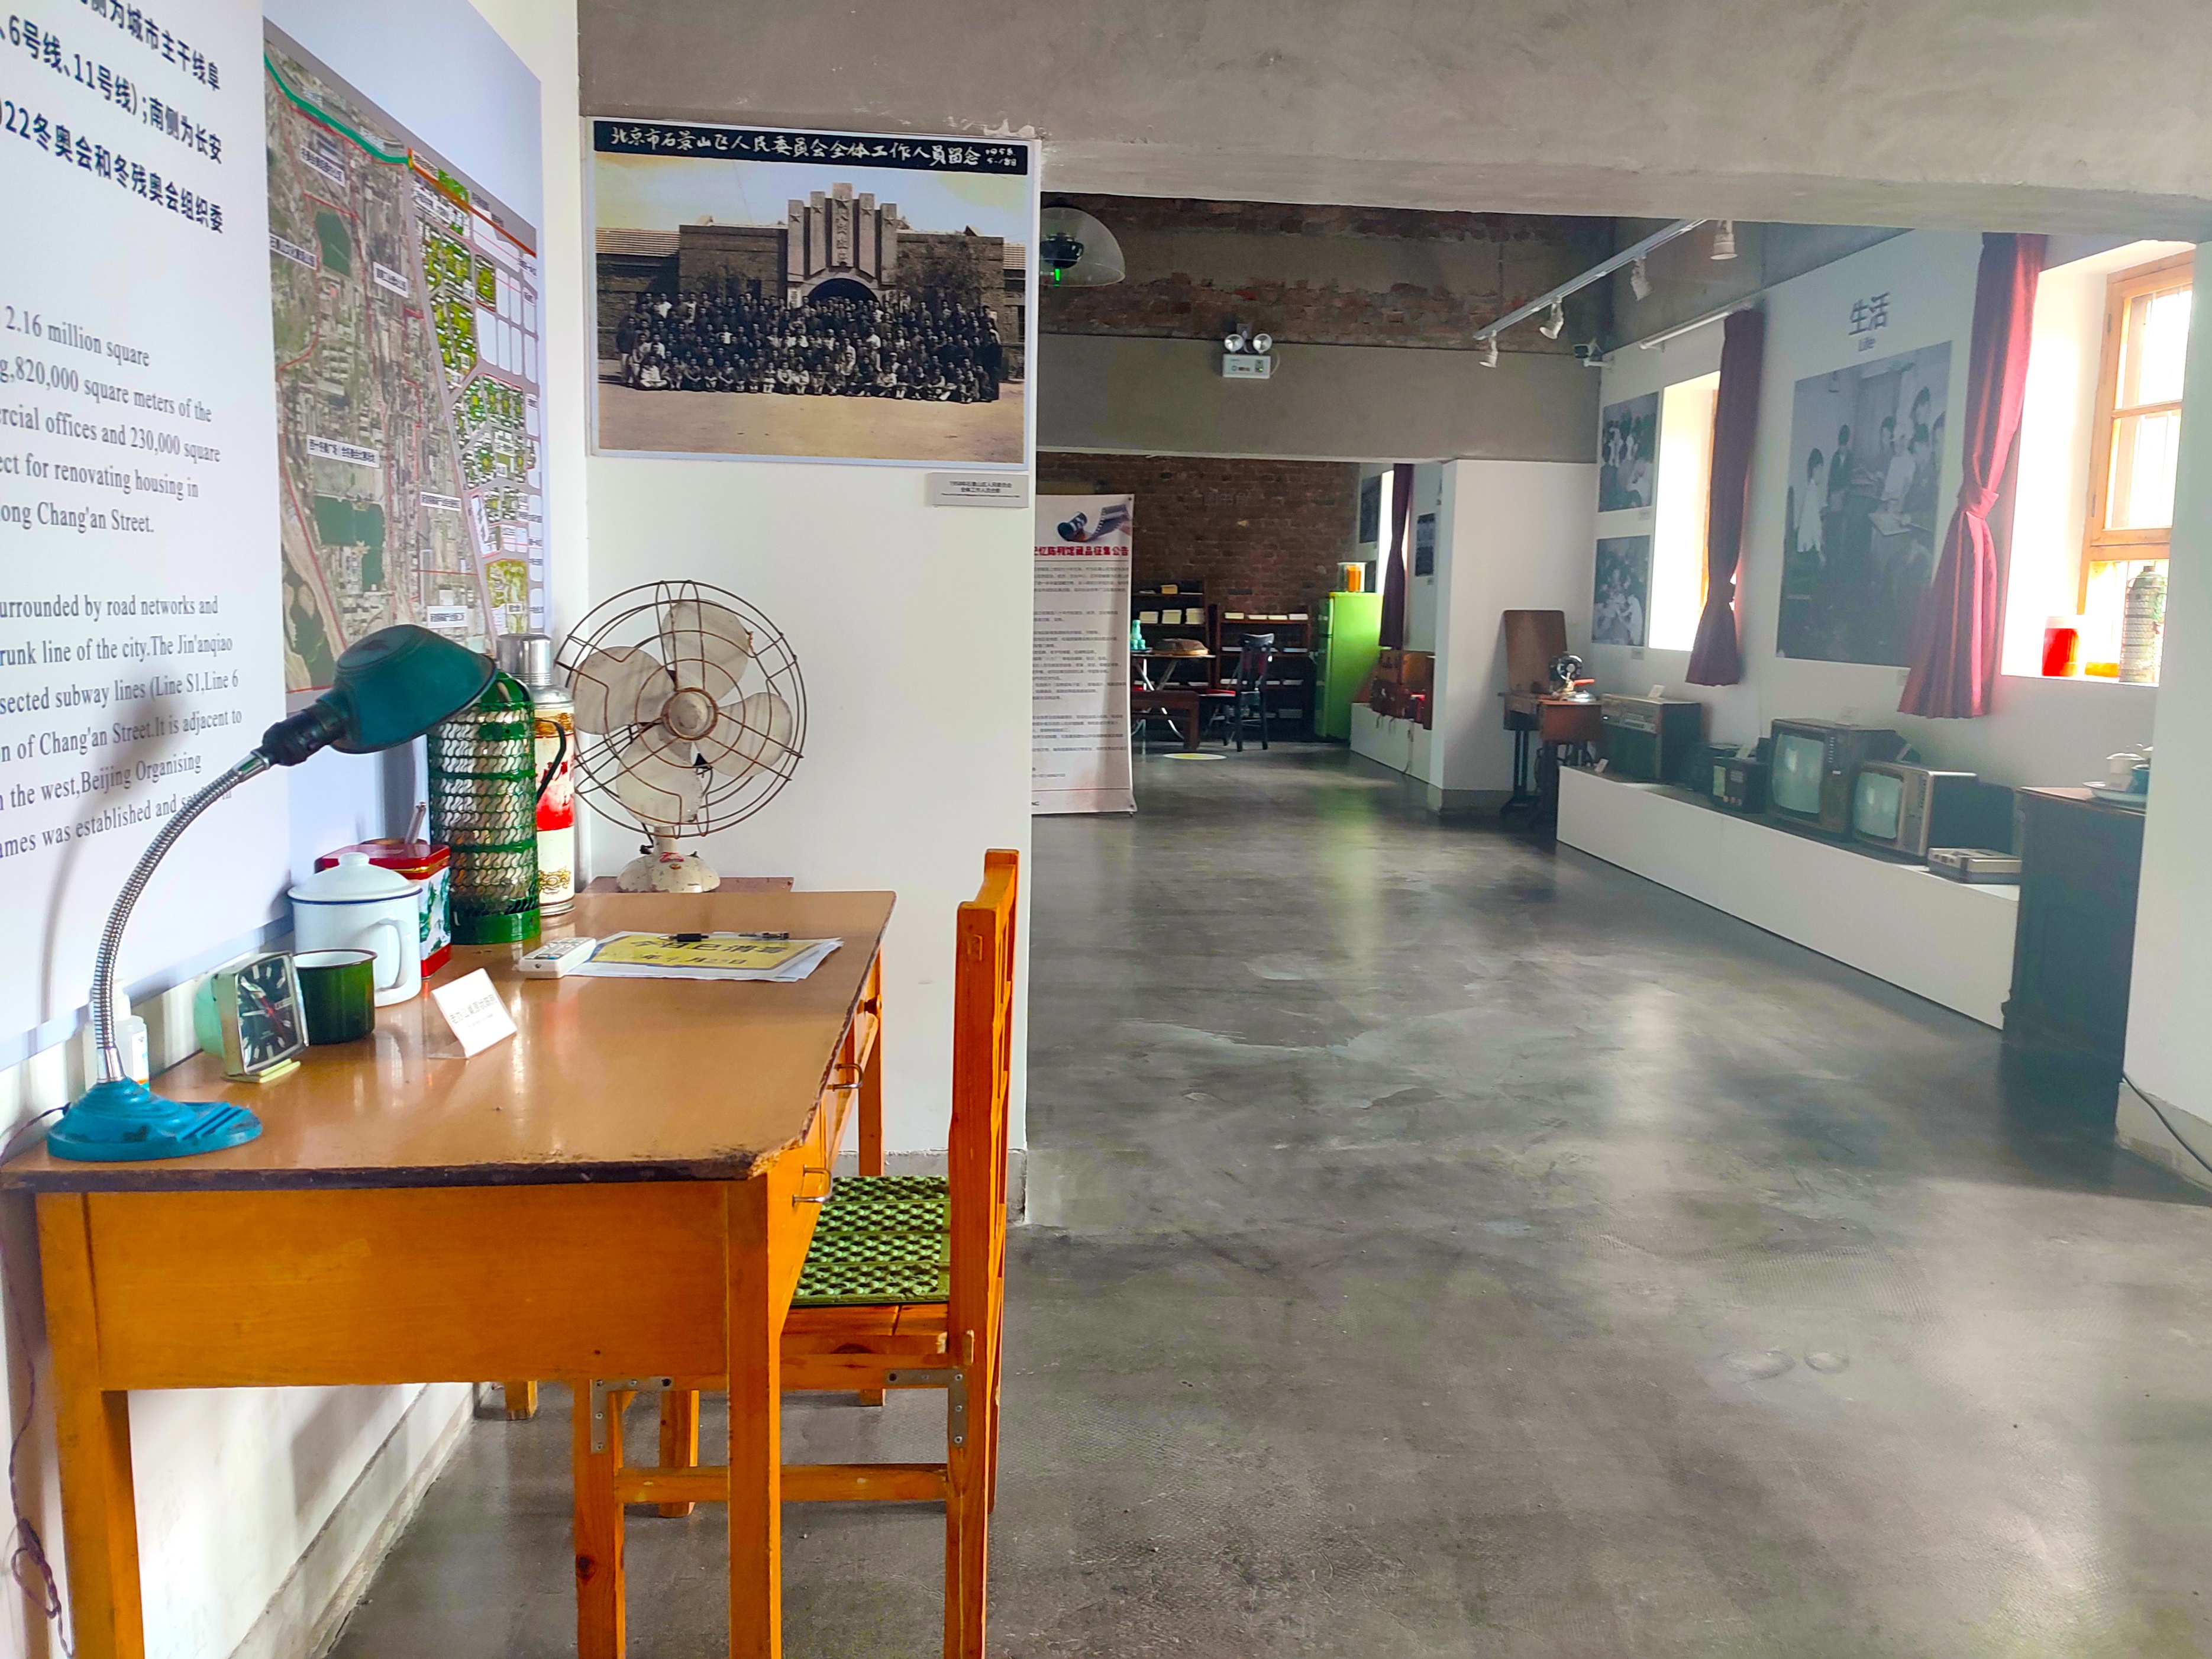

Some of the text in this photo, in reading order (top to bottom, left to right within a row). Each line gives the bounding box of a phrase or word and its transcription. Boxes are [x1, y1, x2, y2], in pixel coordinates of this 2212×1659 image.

[0, 98, 222, 234] 22冬奥会和冬残奥会组织委
[5, 306, 150, 366] 2.16 million square
[1849, 292, 1890, 335] 生活
[84, 379, 129, 404] square
[134, 389, 175, 414] meters
[179, 398, 193, 418] of
[194, 401, 212, 422] the
[0, 404, 221, 464] rcial offices and 230,000 square
[25, 452, 49, 478] for
[54, 463, 131, 495] renovating
[135, 469, 185, 501] housing
[187, 477, 199, 498] in
[1, 501, 154, 534] ong Chang'an Street.
[0, 595, 218, 622] urrounded by road networks and
[0, 641, 37, 666] runk
[43, 640, 71, 663] line
[76, 638, 93, 661] of
[96, 637, 118, 660] the
[177, 633, 233, 657] Jin'anqiao
[0, 686, 50, 715] sected
[56, 684, 109, 709] subway
[115, 679, 146, 702] lines
[150, 675, 182, 702] (Line
[231, 669, 239, 688] 6
[17, 734, 35, 760] of
[40, 727, 108, 756] Chang'an
[169, 713, 179, 734] is
[183, 710, 229, 735] adjacent
[231, 709, 243, 724] to
[11, 783, 35, 808] the
[135, 751, 202, 785] Organising
[42, 825, 71, 847] was
[76, 799, 151, 838] established
[155, 793, 177, 818] and
